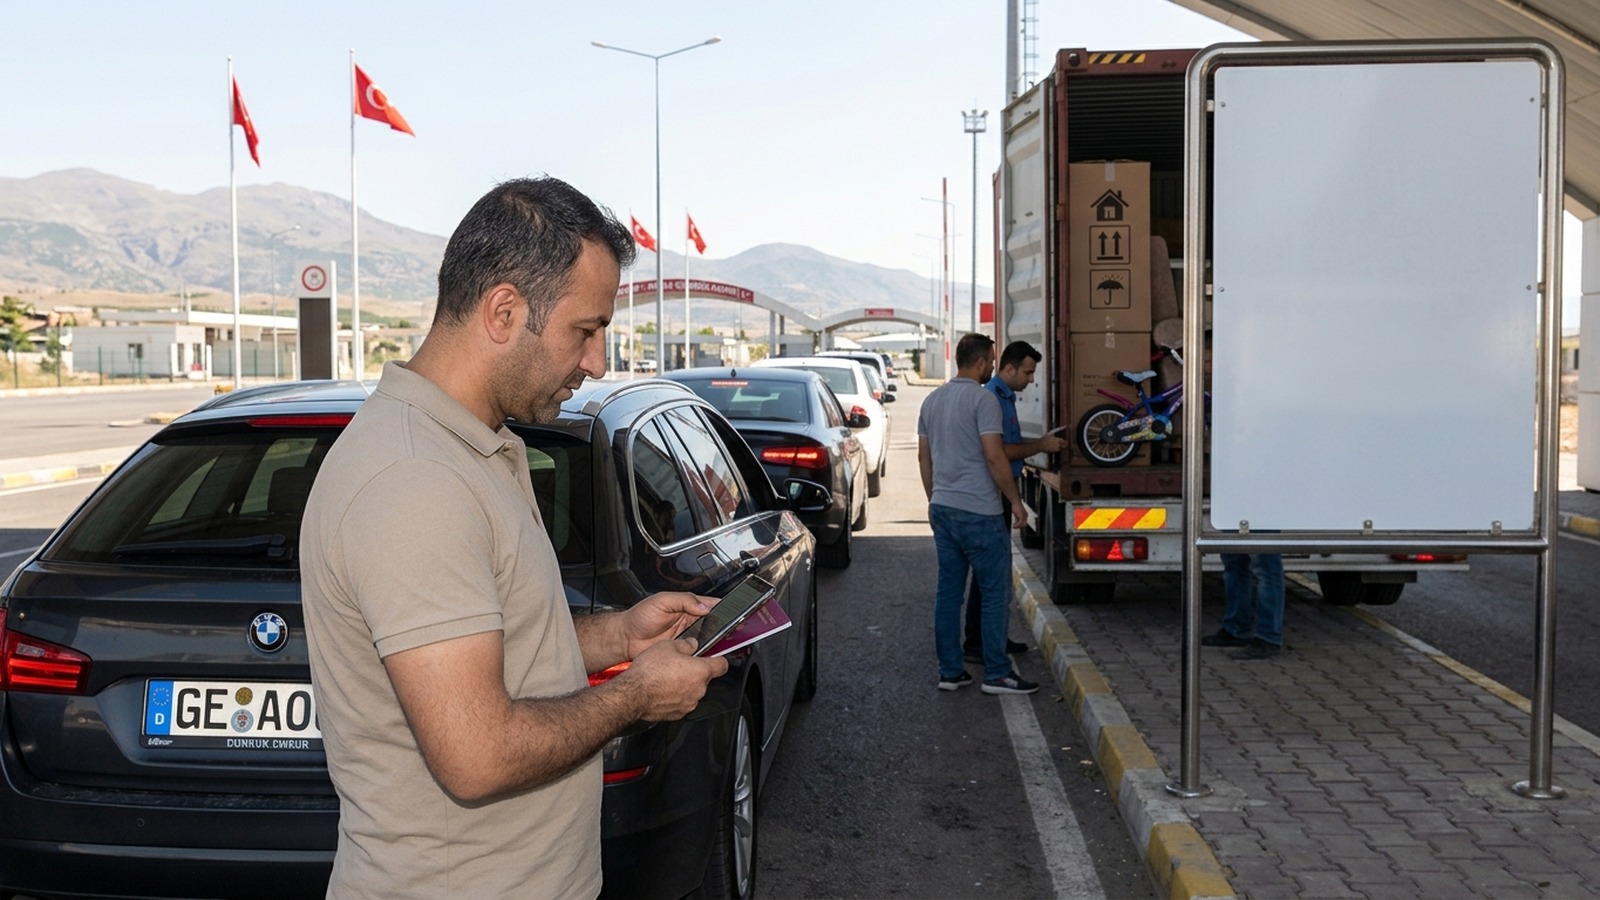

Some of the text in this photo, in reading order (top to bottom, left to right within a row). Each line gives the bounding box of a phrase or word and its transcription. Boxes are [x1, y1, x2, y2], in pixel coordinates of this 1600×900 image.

[154, 713, 165, 726] D
[176, 687, 321, 732] GE AO
